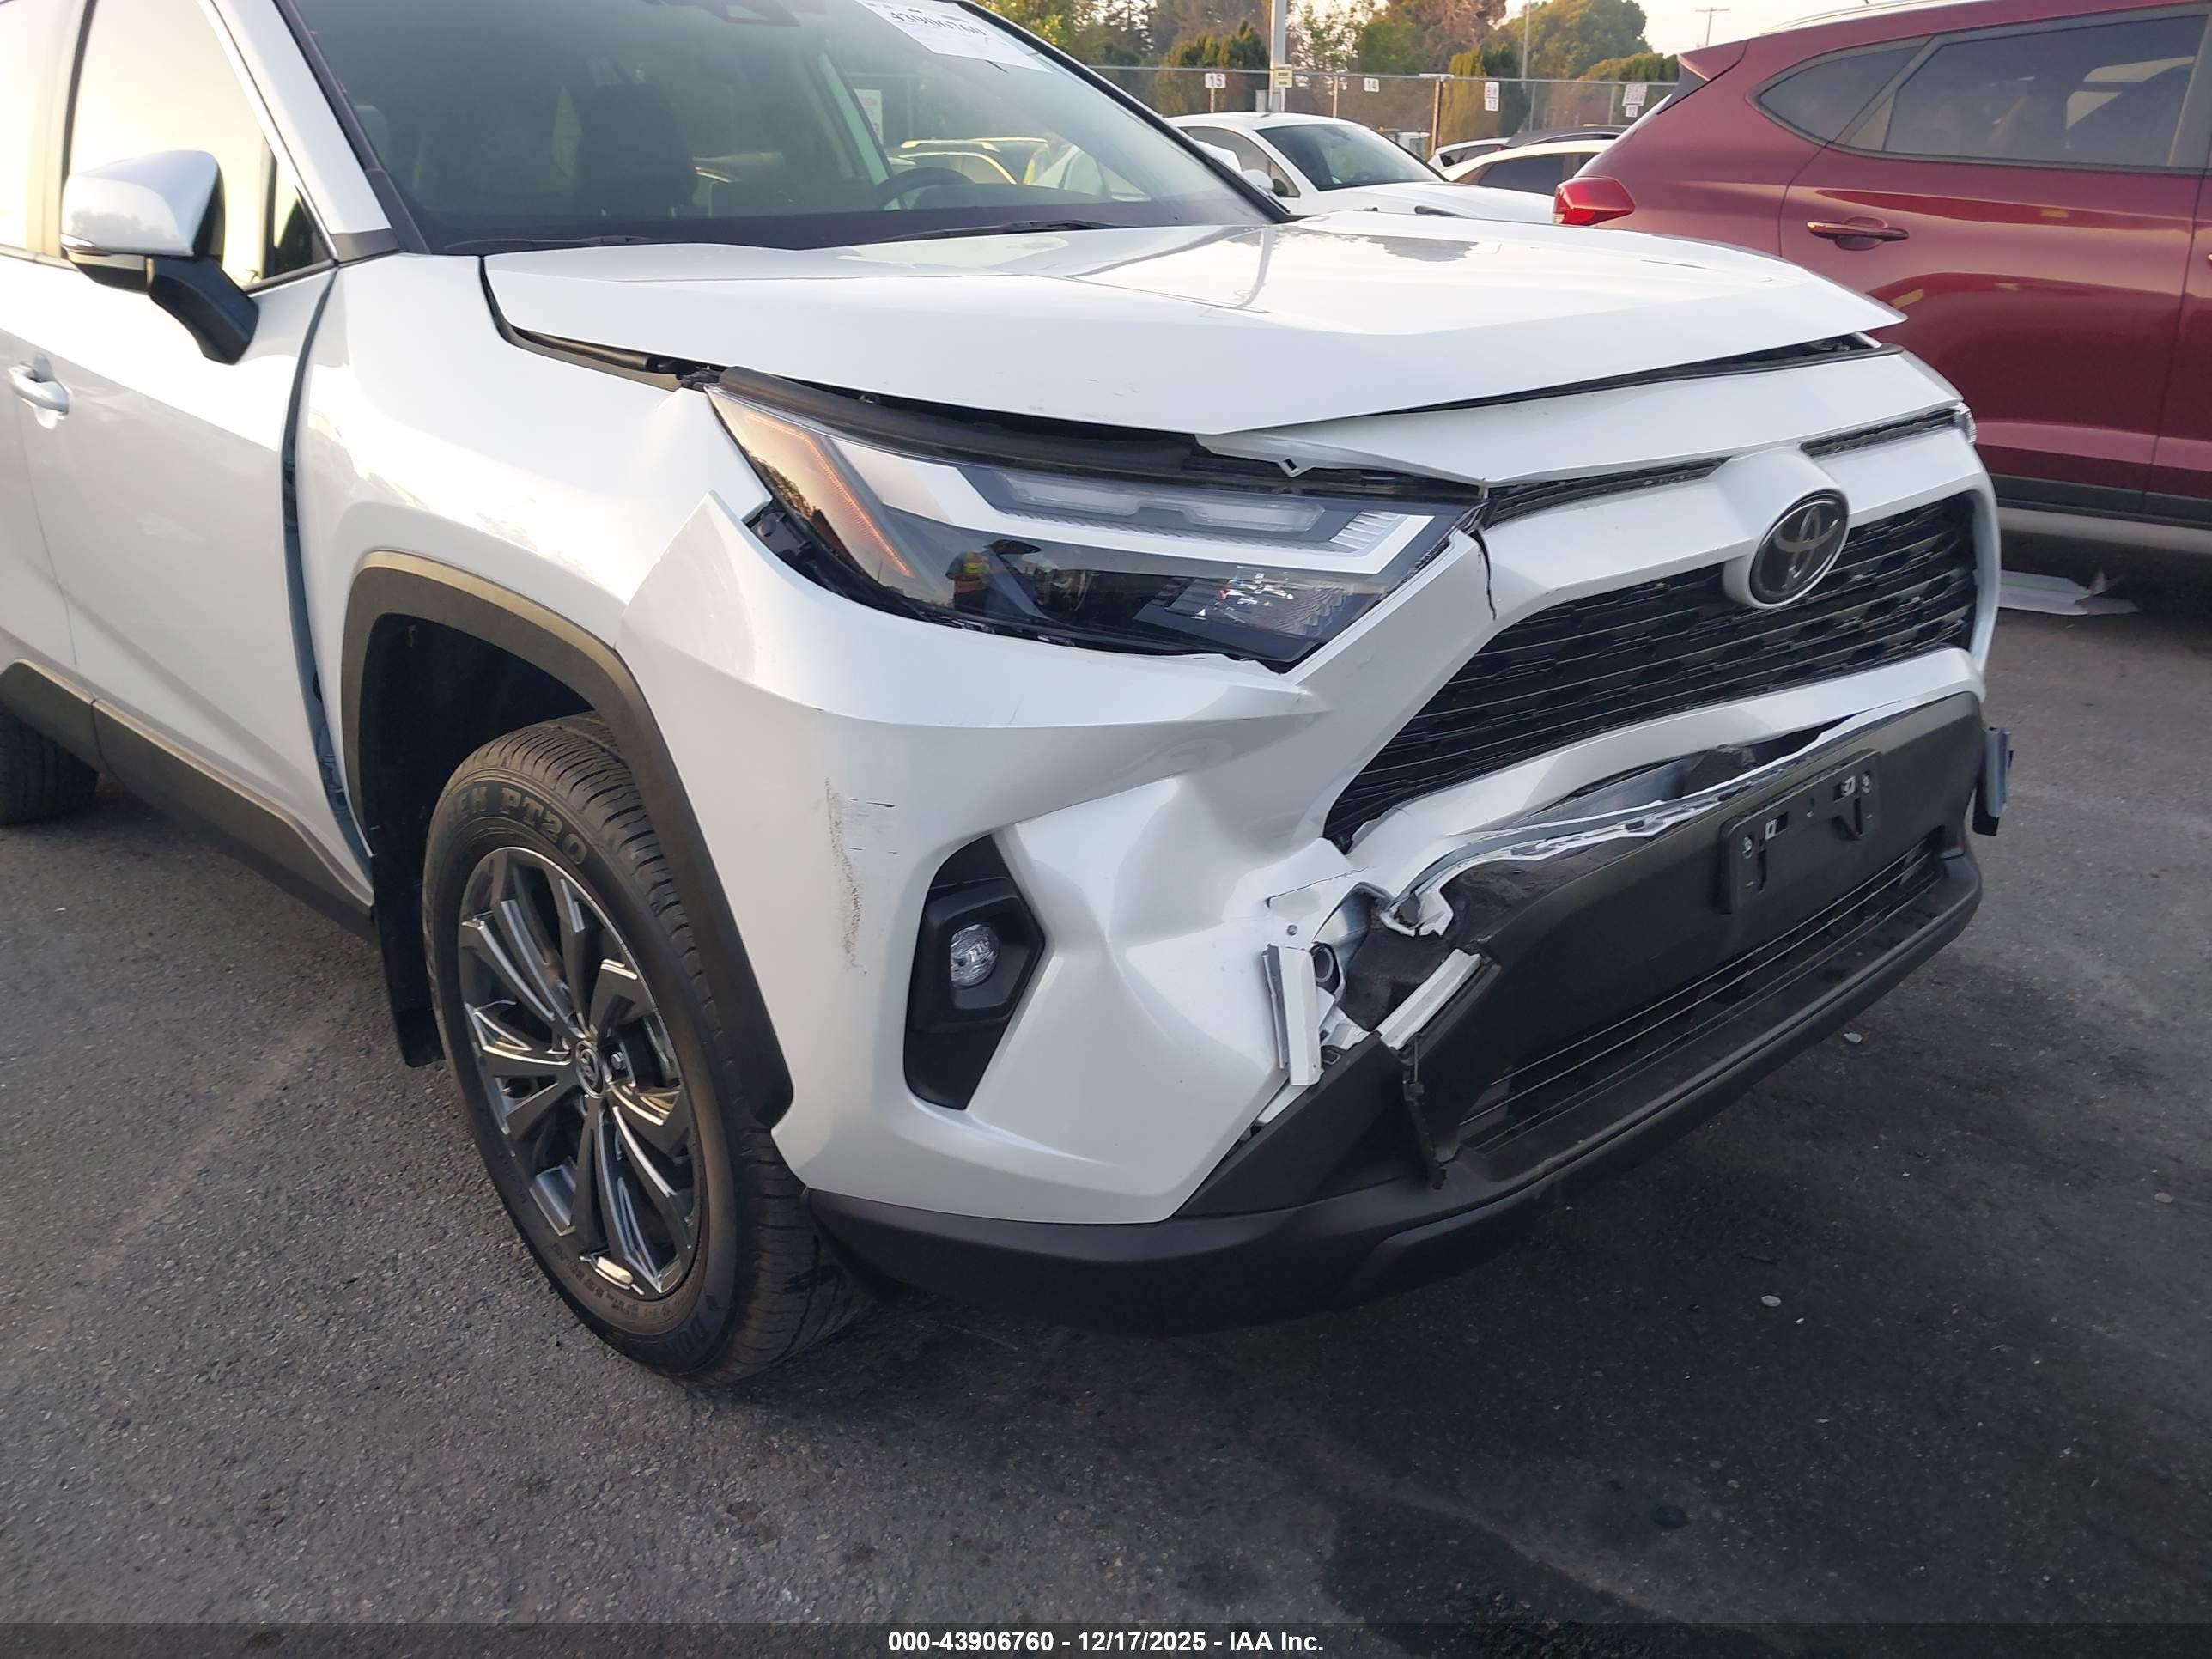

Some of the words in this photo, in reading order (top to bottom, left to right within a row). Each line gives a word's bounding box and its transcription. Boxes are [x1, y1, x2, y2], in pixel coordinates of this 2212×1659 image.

[1209, 74, 1223, 87] 15
[1366, 80, 1377, 90] 14
[500, 787, 588, 866] PT20
